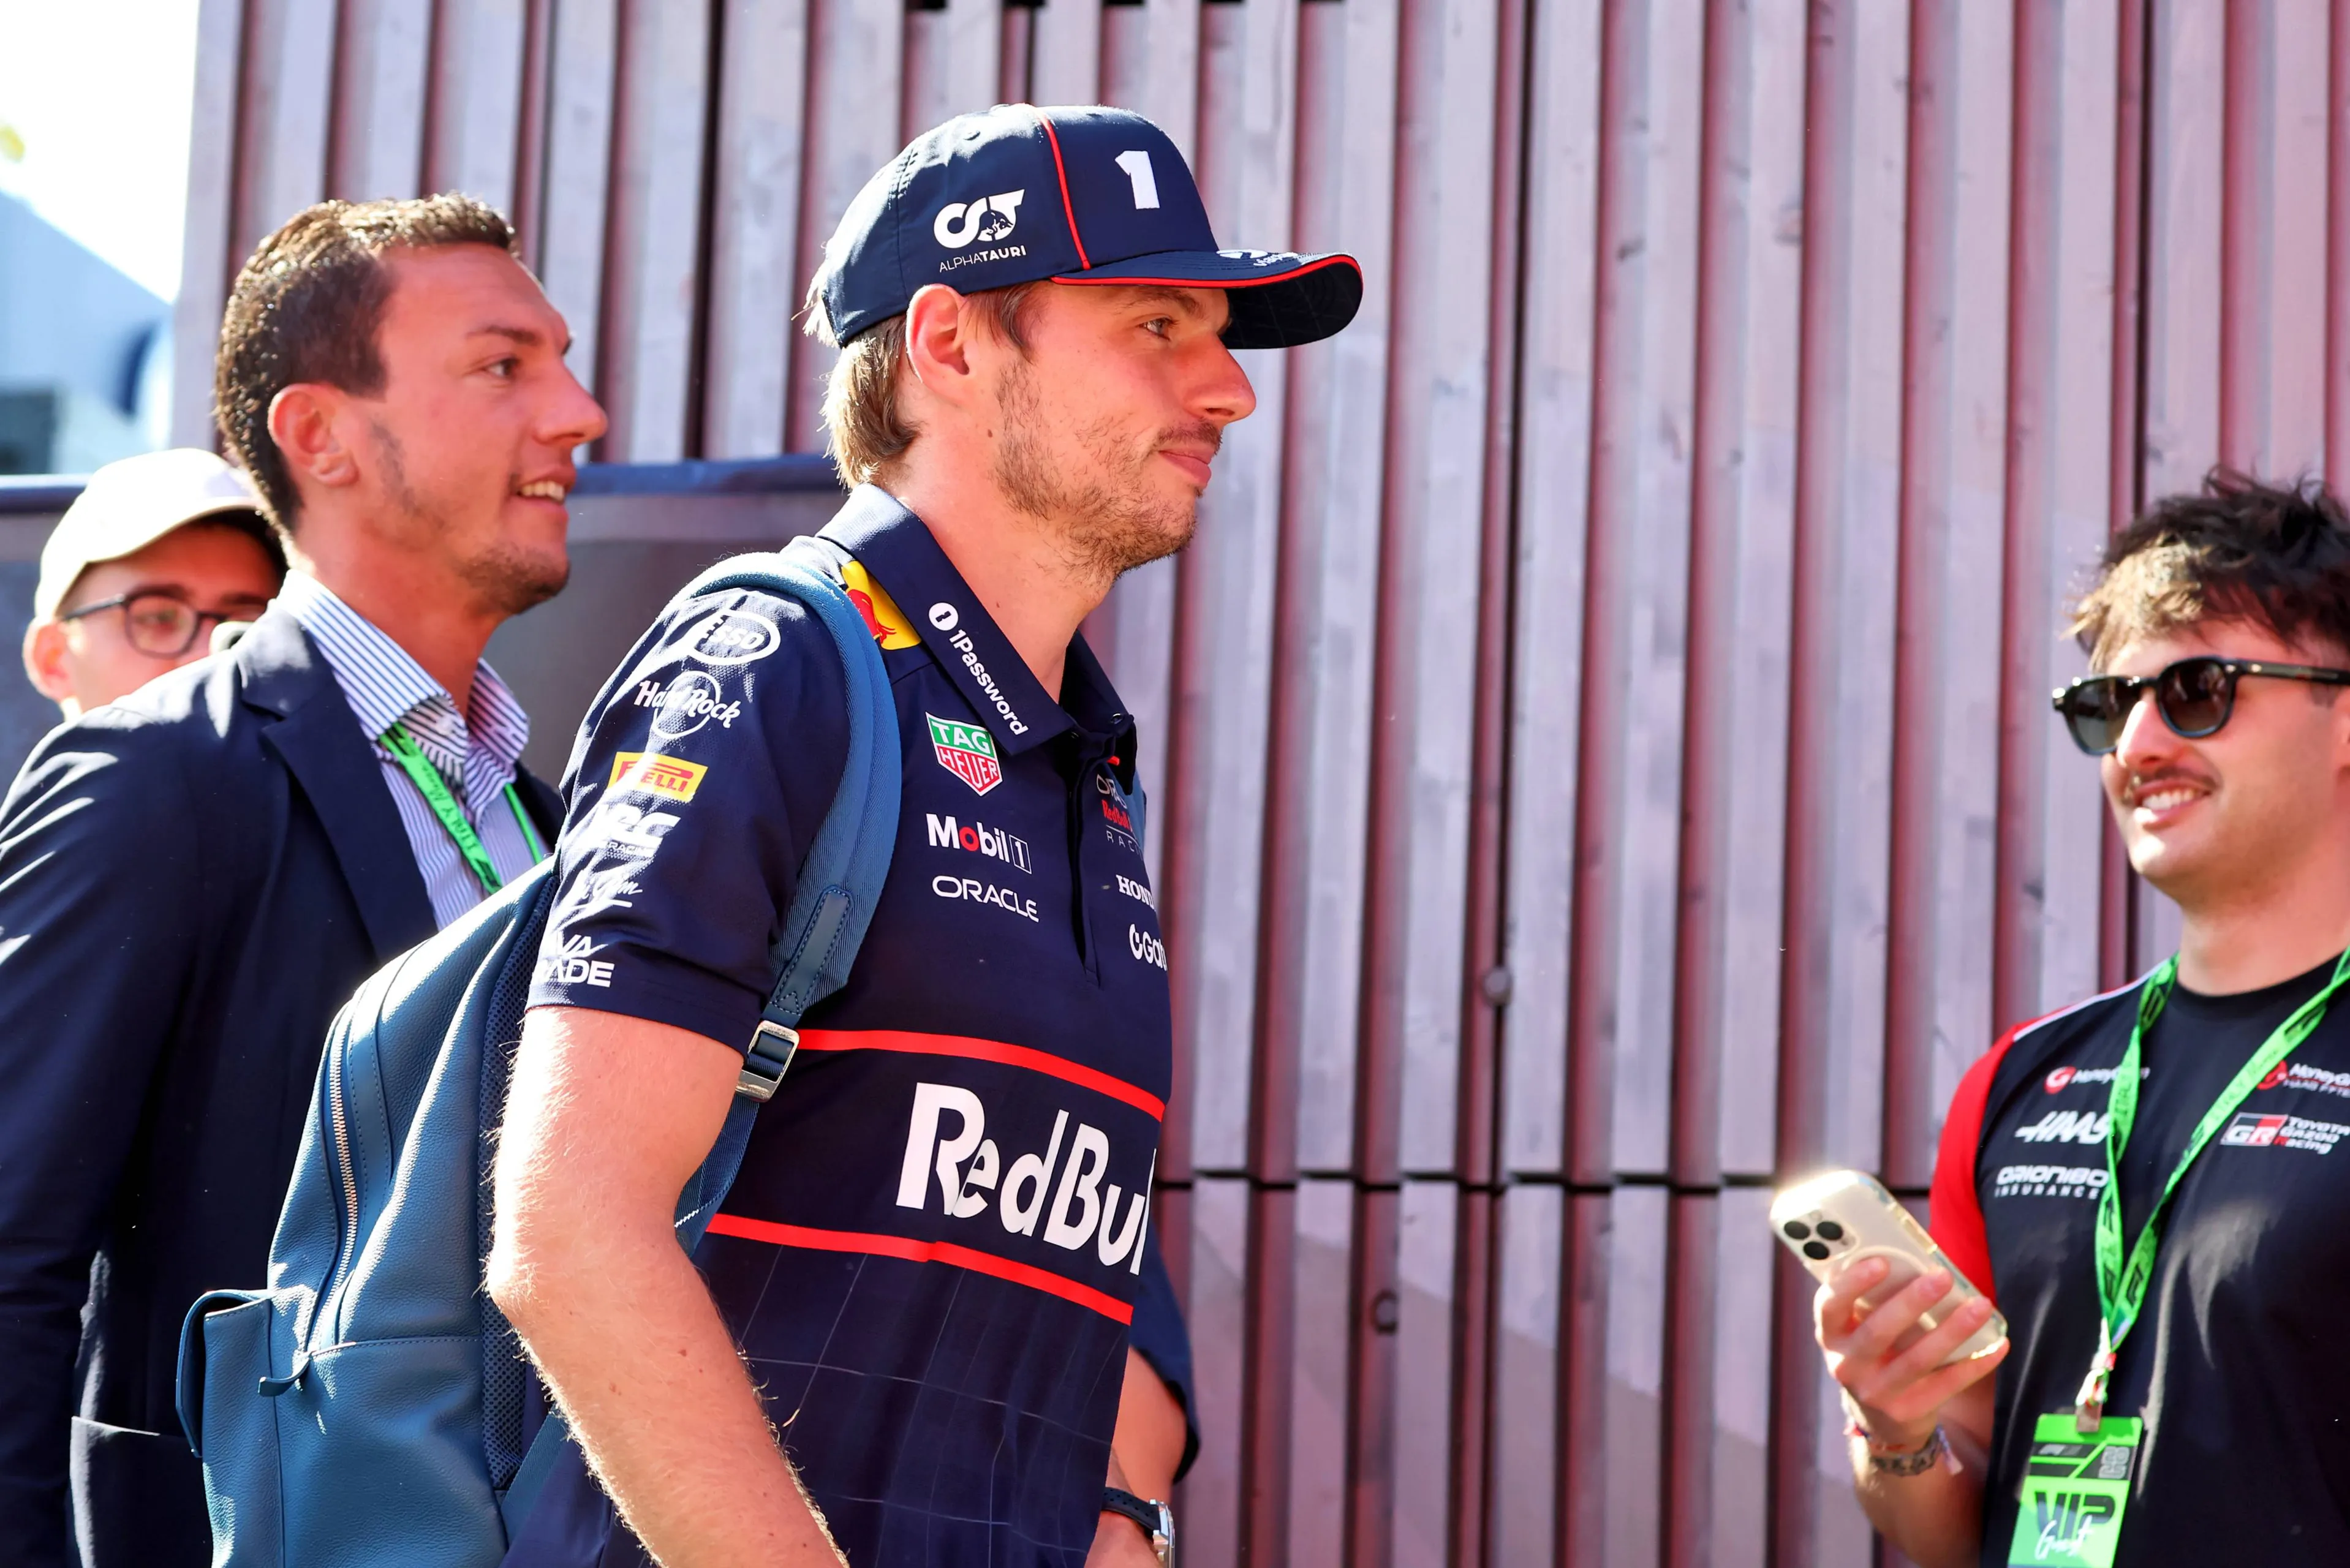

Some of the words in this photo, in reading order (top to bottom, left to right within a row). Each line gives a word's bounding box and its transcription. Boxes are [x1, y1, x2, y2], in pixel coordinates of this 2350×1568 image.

[1115, 150, 1160, 209] 1
[939, 245, 1026, 273] ALPHATAURI
[950, 629, 1029, 736] 1Password
[681, 688, 741, 728] Rock
[932, 721, 992, 755] TAG
[616, 761, 694, 792] PELLI
[942, 747, 999, 790] HEUER
[926, 813, 1009, 863] Mobil
[1106, 831, 1143, 861] RACI
[932, 876, 1039, 922] ORACLE
[1116, 874, 1156, 911] HOND
[529, 957, 615, 988] ADE
[2227, 1126, 2279, 1144] GR
[2280, 1126, 2340, 1144] GAZOO
[2289, 1116, 2350, 1137] TOYOTA
[2273, 1135, 2333, 1155] Racing
[1994, 1183, 2100, 1200] INSURANCE
[2034, 1491, 2116, 1540] VIP
